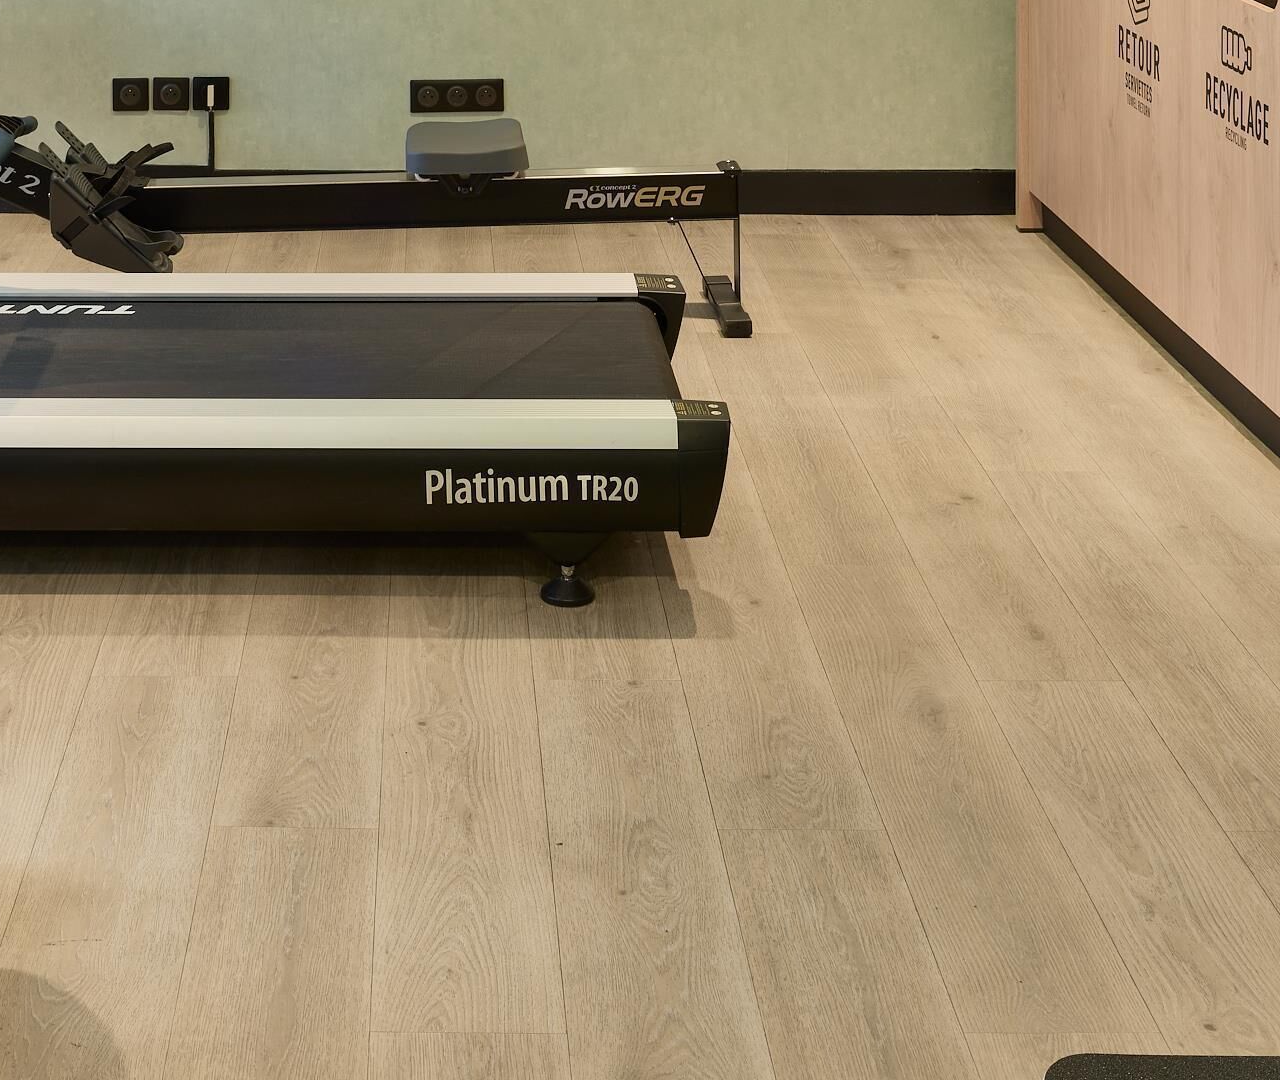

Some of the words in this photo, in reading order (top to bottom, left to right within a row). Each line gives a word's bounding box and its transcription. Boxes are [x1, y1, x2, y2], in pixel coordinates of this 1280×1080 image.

[1119, 24, 1160, 81] RETOUR
[1125, 71, 1152, 103] SERVIETTES
[1206, 72, 1269, 145] RECYCLAGE
[1225, 126, 1247, 150] RECYCLING
[19, 174, 41, 195] 2
[425, 468, 569, 504] Platinum
[577, 474, 639, 502] TR20
